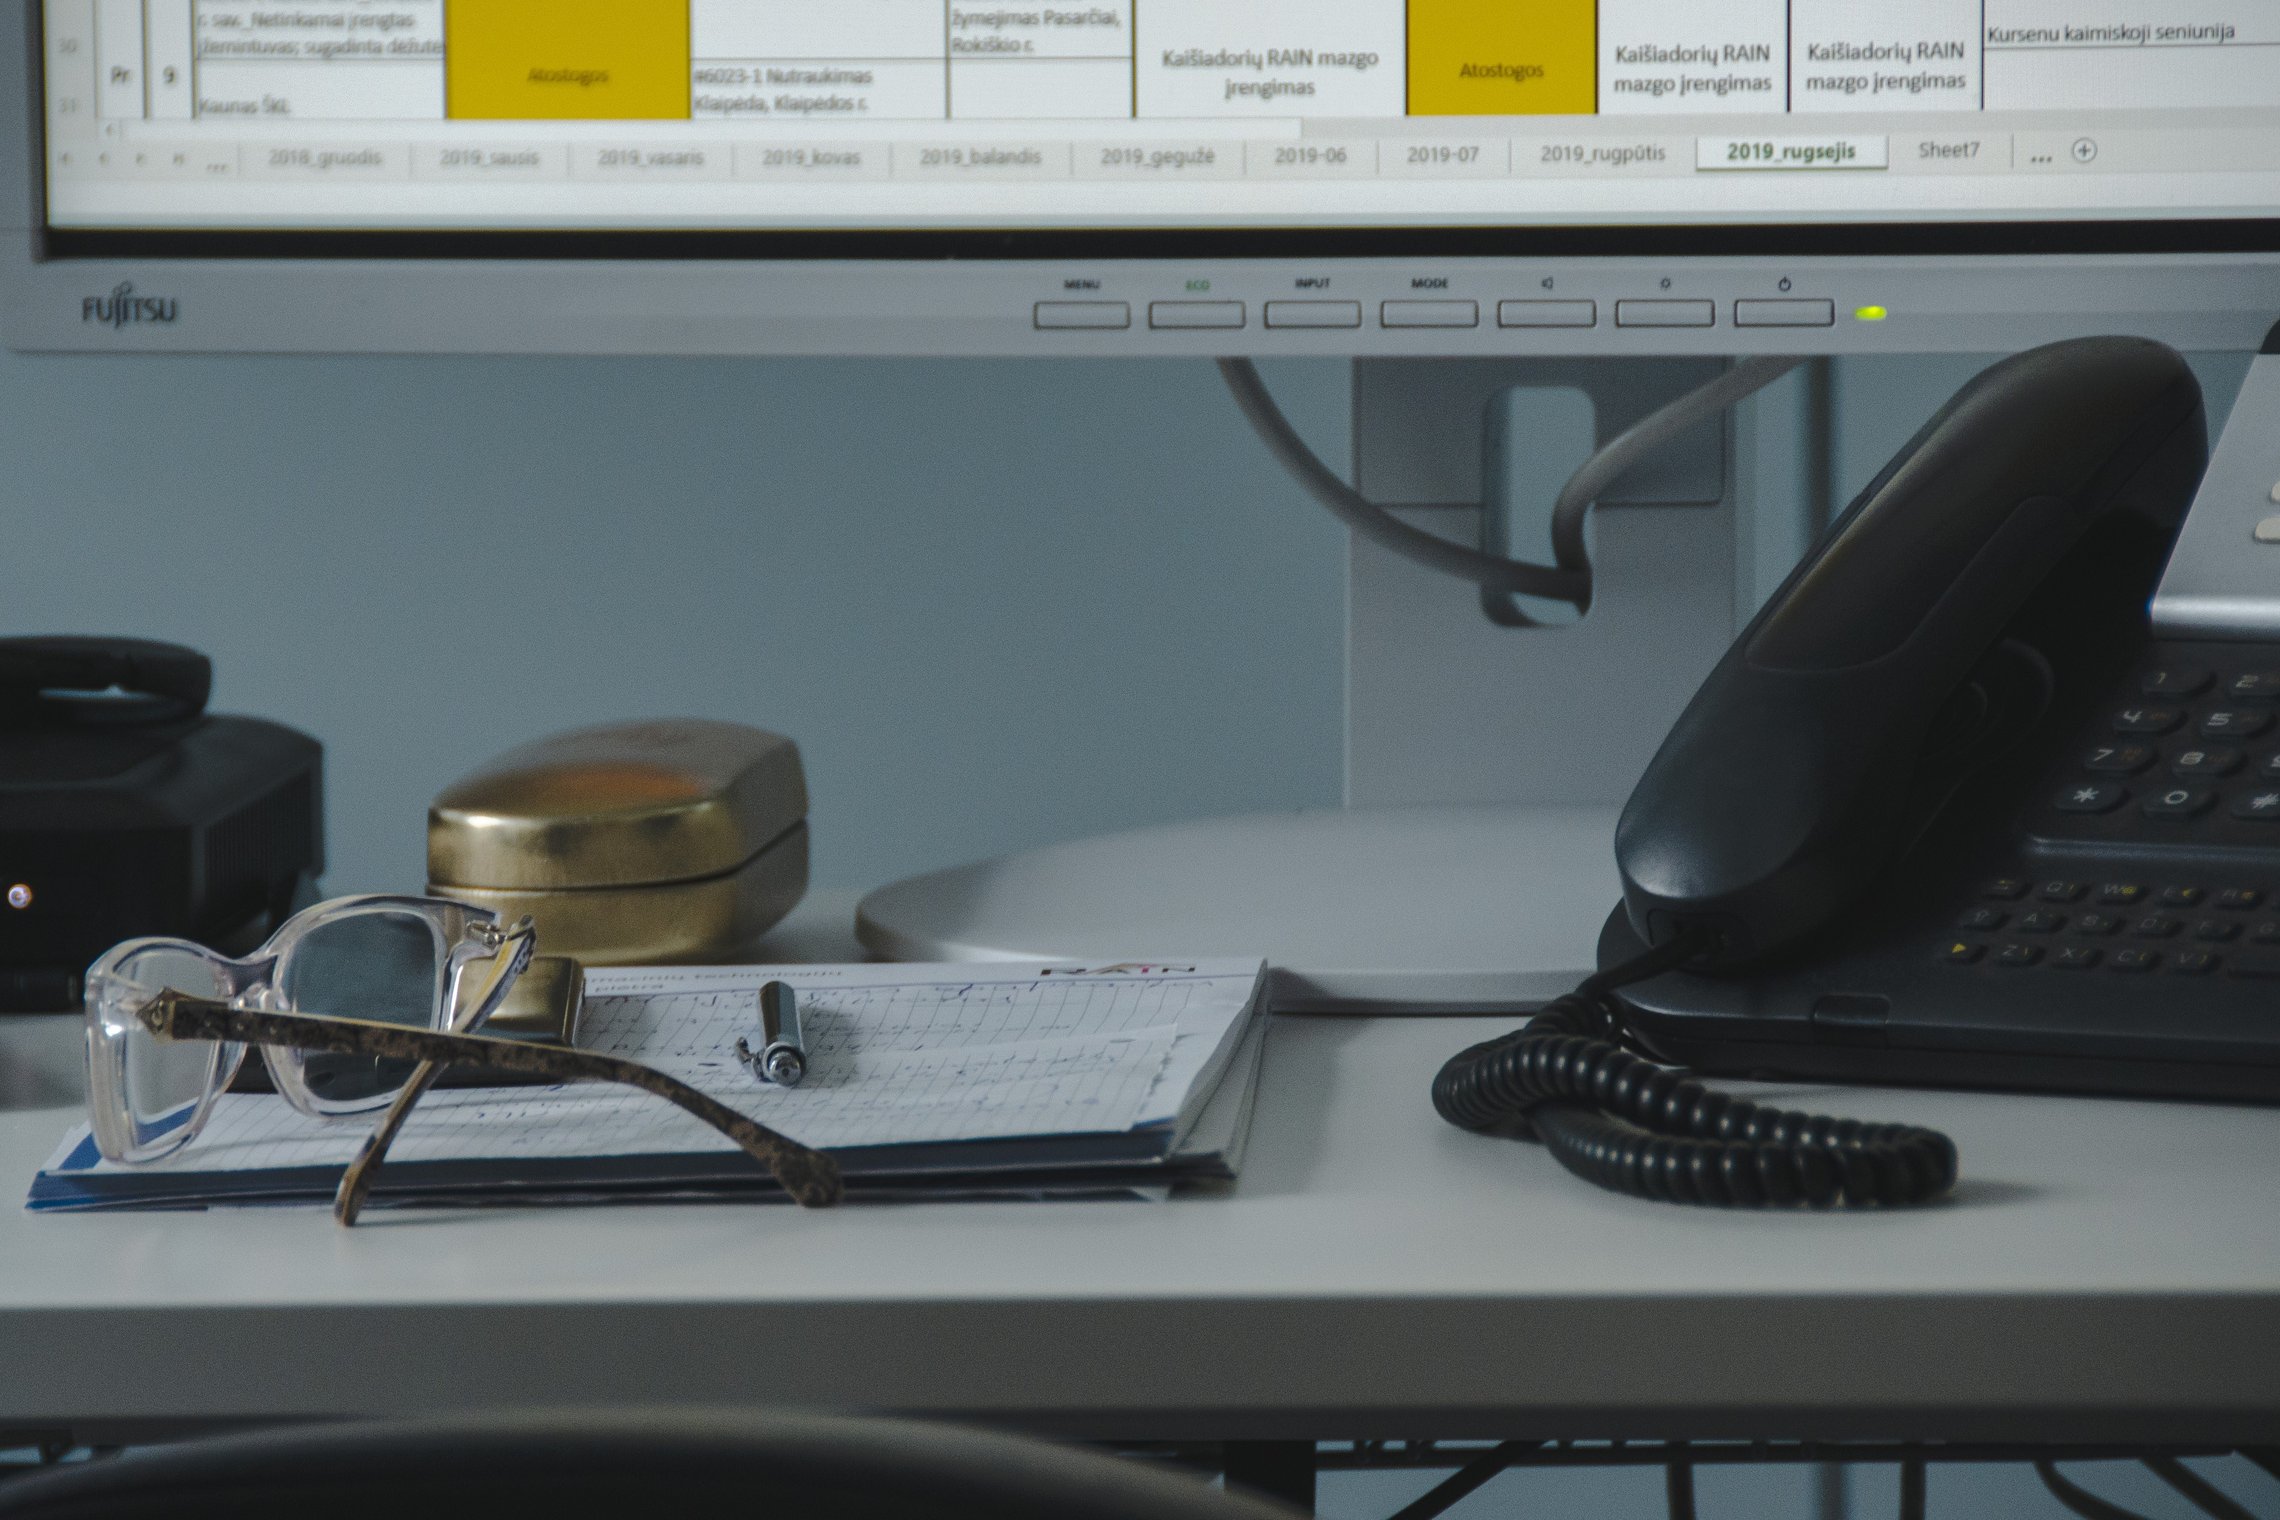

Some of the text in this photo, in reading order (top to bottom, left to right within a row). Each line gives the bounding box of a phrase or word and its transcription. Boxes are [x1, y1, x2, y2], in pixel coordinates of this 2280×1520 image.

[1162, 47, 1379, 71] Kaišiadorių RAIN mazgo
[1615, 42, 1772, 67] Kaišiadorių RAIN
[1807, 40, 1965, 64] Kaišiadorių RAIN
[1459, 61, 1545, 81] Atostogos
[1225, 78, 1316, 98] įrengimas
[1613, 74, 1773, 98] mazgo įrengimas
[1805, 72, 1966, 94] mazgo įrengimas
[761, 149, 862, 167] 2019_kovas
[1274, 147, 1348, 164] 2019-06
[1407, 146, 1480, 164] 2019-07
[1541, 144, 1667, 167] 2019_rugpūtis
[1726, 141, 1857, 163] 2019_rugsejis
[1919, 141, 1981, 159] Sheet7
[82, 281, 177, 329] FUJITSU
[2121, 708, 2144, 724] 4
[2206, 711, 2234, 727] 5
[2093, 747, 2117, 763] 7
